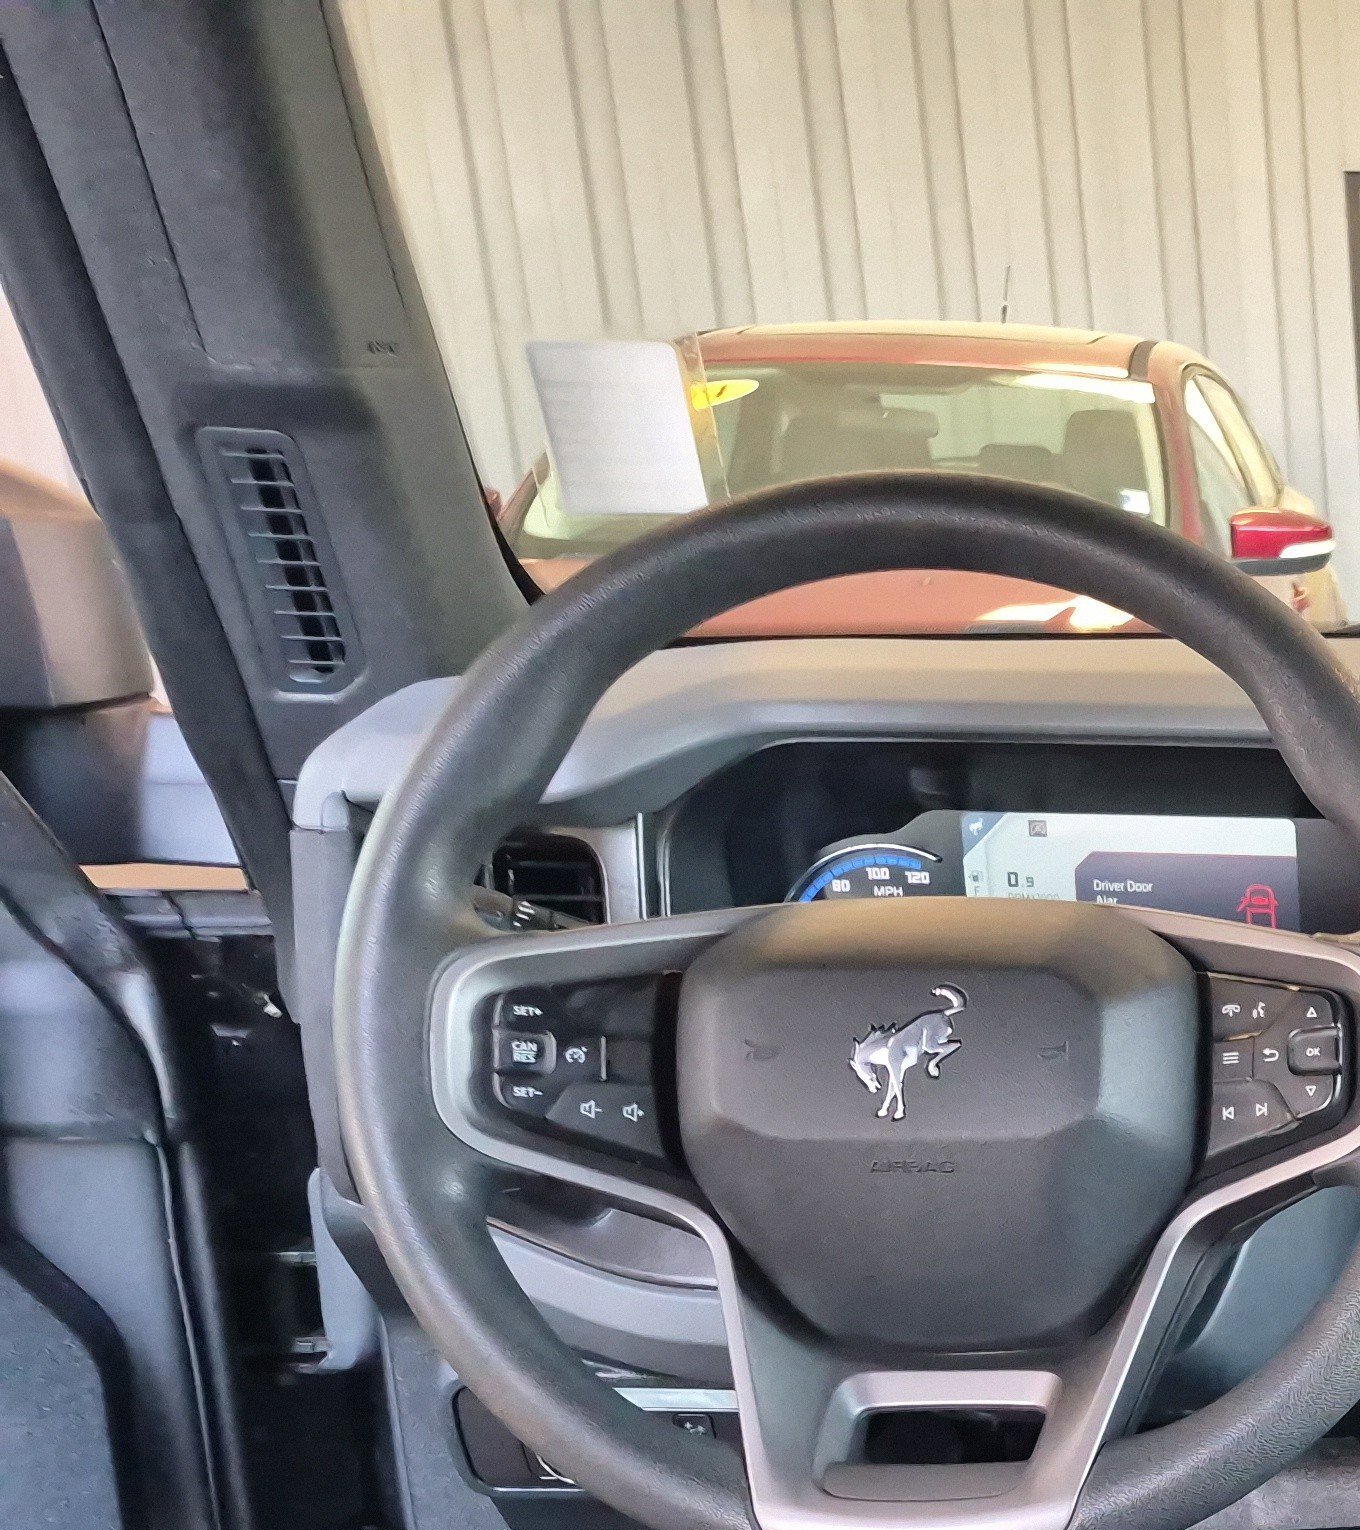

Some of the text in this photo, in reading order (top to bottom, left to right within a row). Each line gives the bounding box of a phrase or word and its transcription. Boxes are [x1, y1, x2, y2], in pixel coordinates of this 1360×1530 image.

[865, 867, 890, 881] 100
[904, 871, 930, 884] 120
[874, 885, 903, 897] MPH
[1093, 879, 1153, 892] Driver Door
[511, 1041, 538, 1051] CAN
[1306, 1047, 1321, 1057] OK
